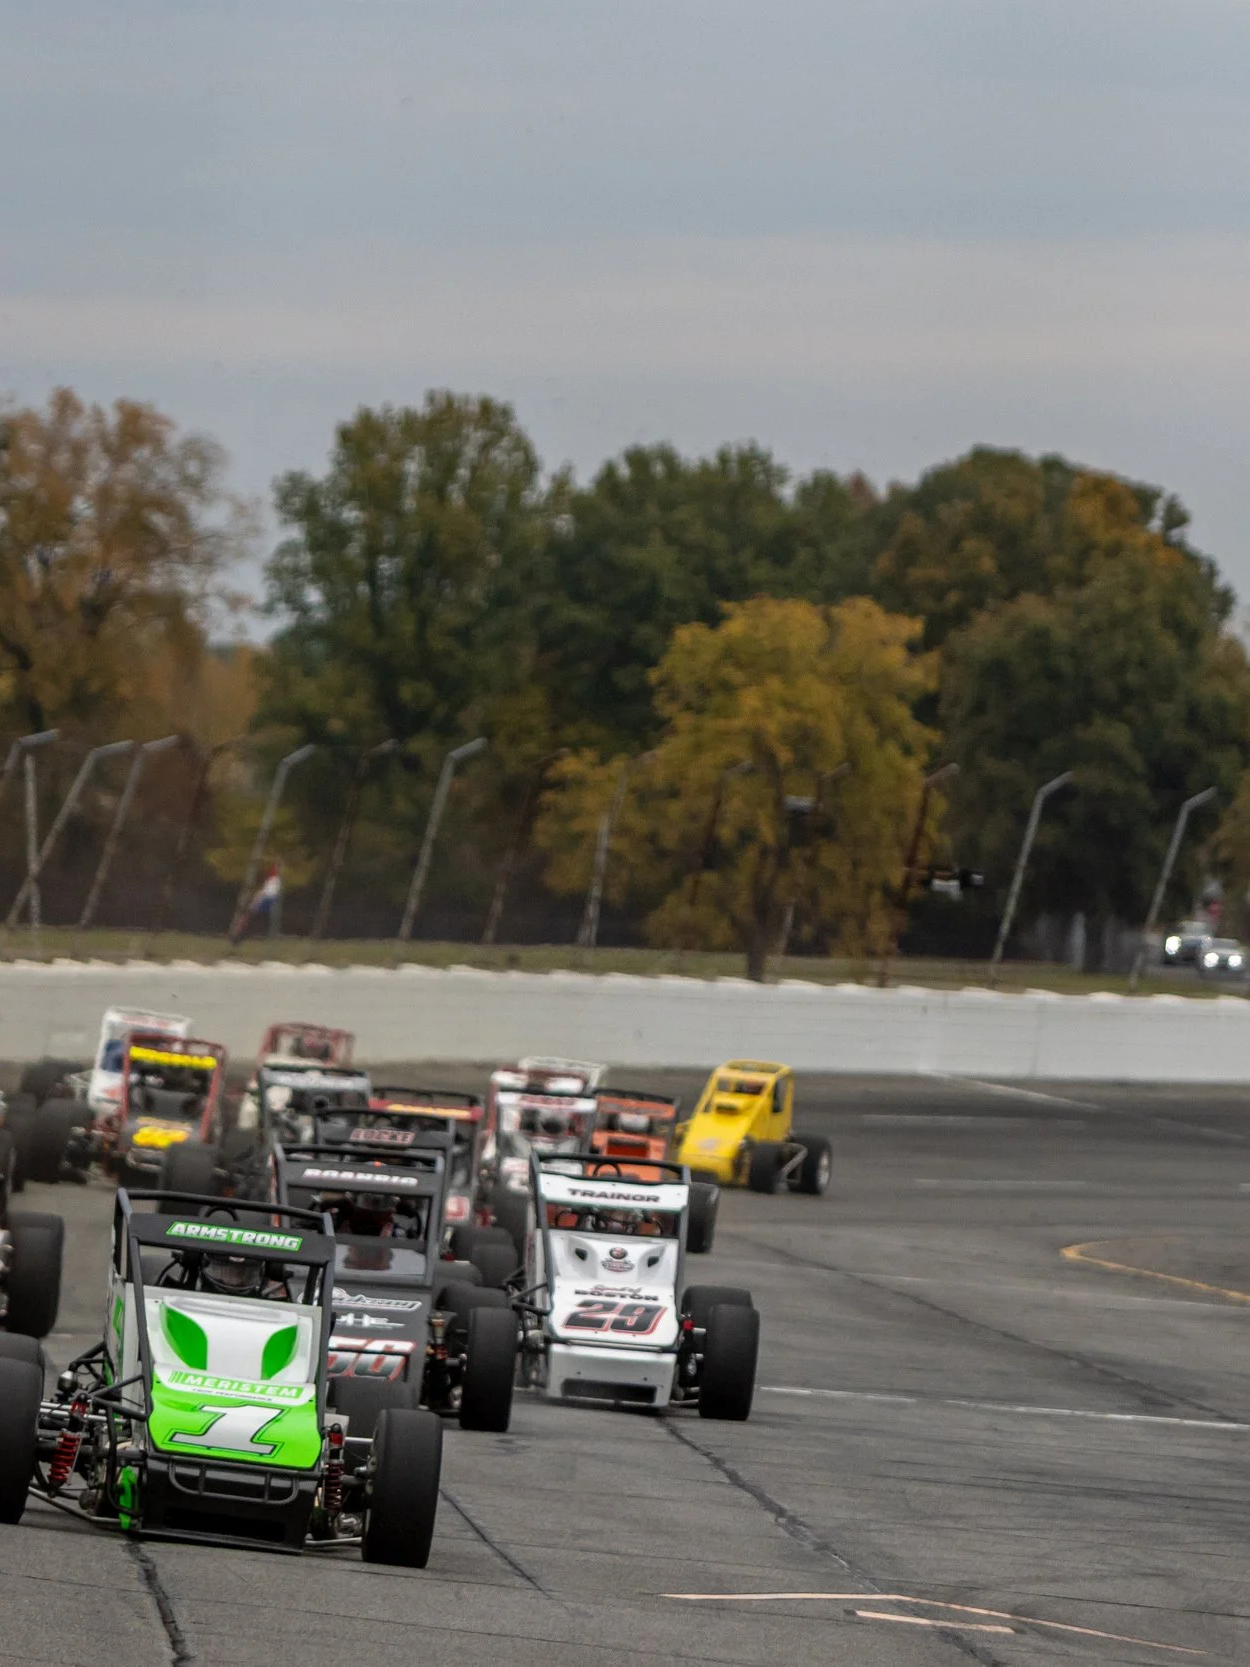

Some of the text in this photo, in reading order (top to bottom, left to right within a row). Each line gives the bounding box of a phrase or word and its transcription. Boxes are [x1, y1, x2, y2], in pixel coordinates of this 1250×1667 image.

[567, 1187, 661, 1203] TRAINOR
[171, 1222, 300, 1249] ARMSTRONG
[562, 1299, 668, 1335] 29
[185, 1375, 300, 1398] MERISTEM
[168, 1403, 286, 1457] 1
